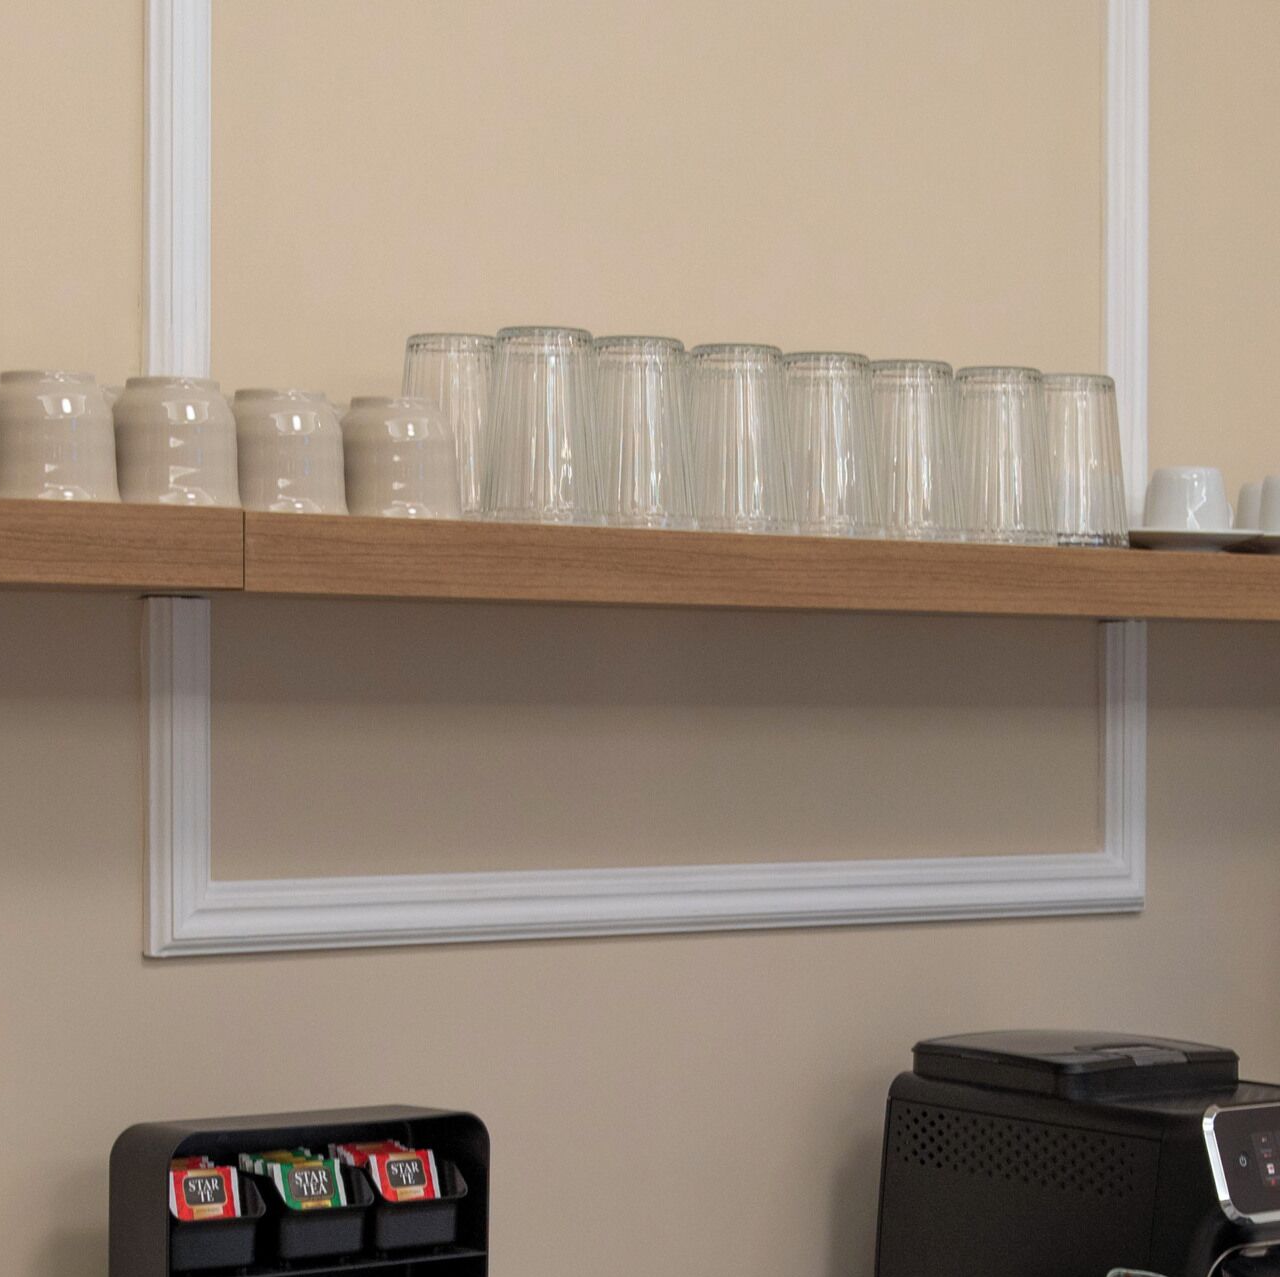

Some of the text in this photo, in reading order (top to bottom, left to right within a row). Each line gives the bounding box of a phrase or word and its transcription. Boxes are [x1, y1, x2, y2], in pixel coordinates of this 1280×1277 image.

[391, 1161, 420, 1175] STAR
[294, 1169, 328, 1187] STAR
[188, 1178, 220, 1193] STAR
[300, 1182, 328, 1196] TEA
